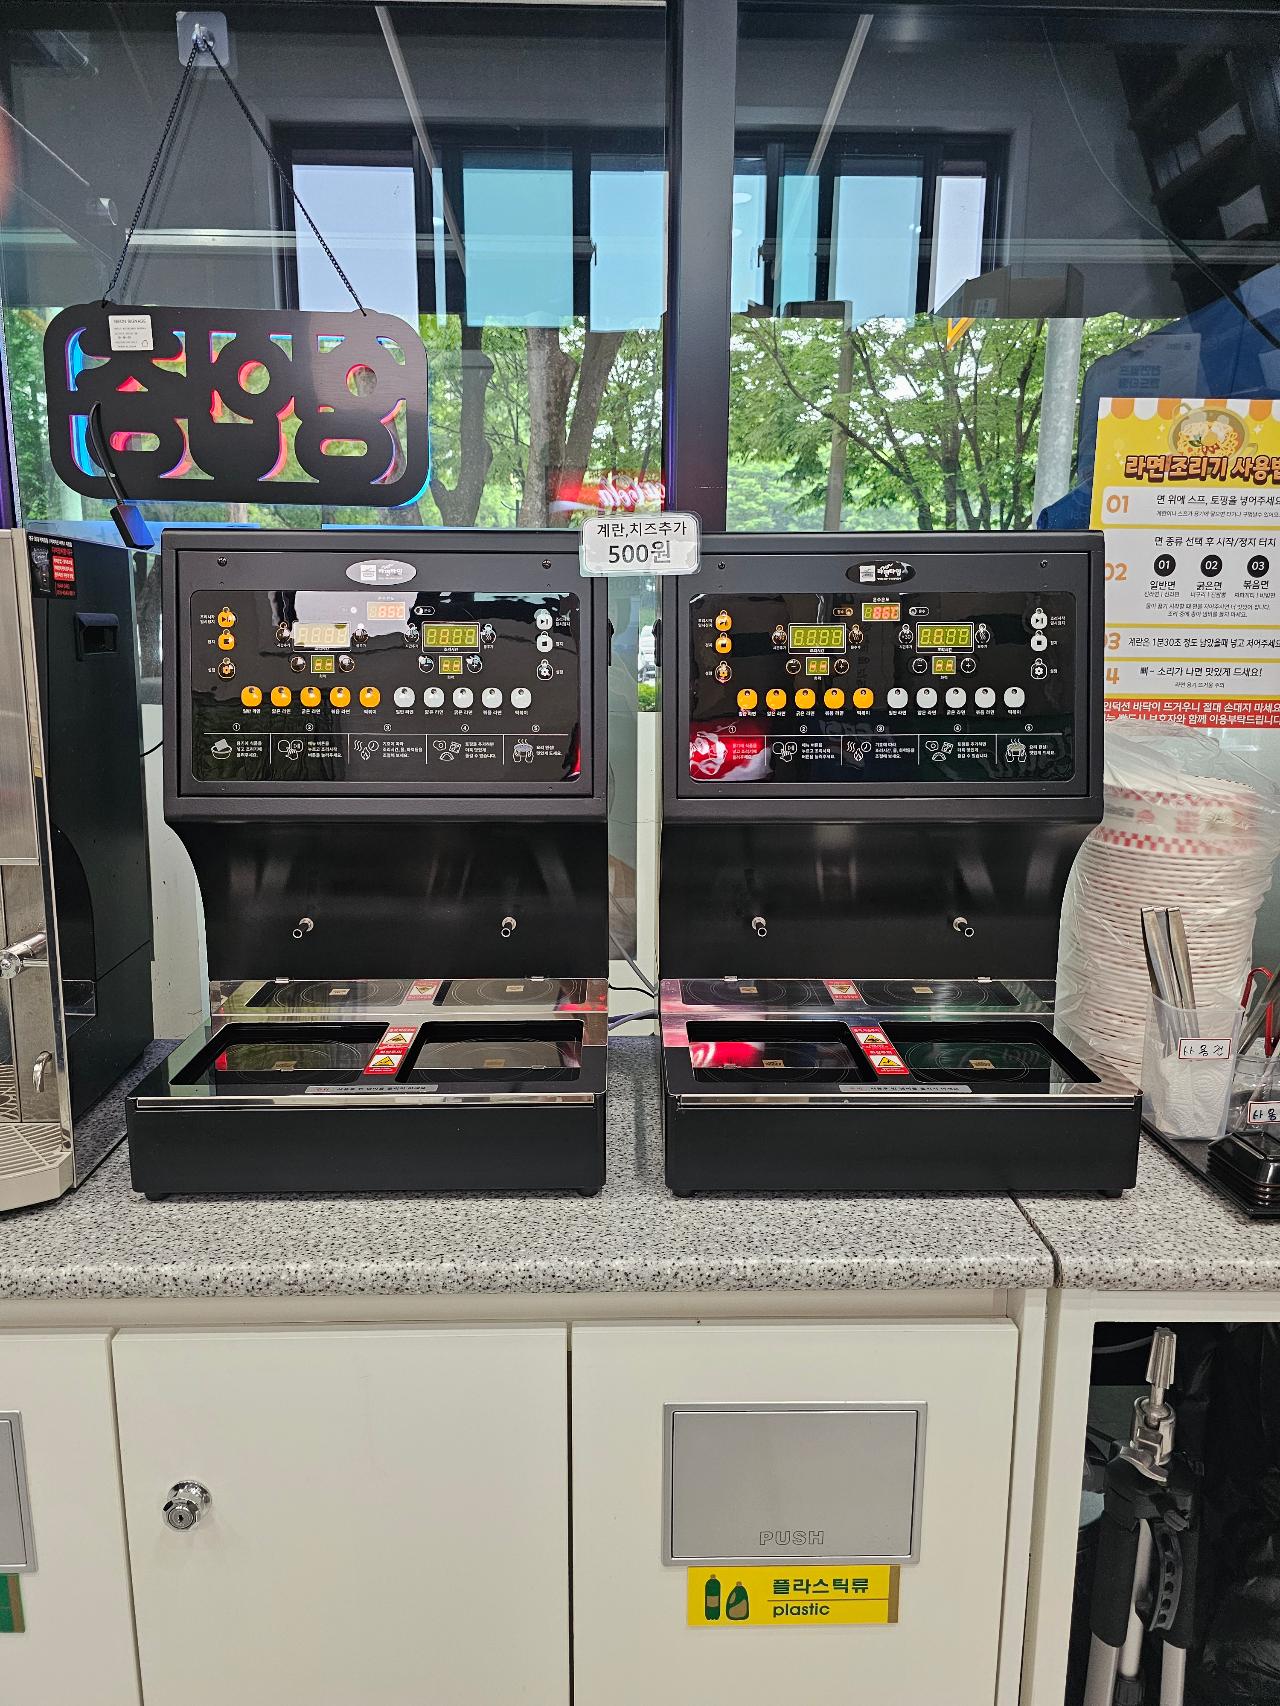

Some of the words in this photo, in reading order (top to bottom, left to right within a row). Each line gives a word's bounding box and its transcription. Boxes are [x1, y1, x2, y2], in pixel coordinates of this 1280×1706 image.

[1106, 494, 1129, 513] 01
[1157, 495, 1165, 505] 면
[1168, 495, 1185, 505] 위에
[1188, 495, 1208, 505] 스프,
[1210, 495, 1237, 505] 토핑을
[597, 522, 687, 538] 계란,치즈추가
[1155, 537, 1163, 547] 면
[1166, 537, 1183, 547] 종류
[1185, 537, 1203, 547] 선택
[1205, 537, 1214, 547] 후
[1217, 537, 1256, 547] 시작/정지
[1259, 537, 1277, 547] 터치
[608, 540, 671, 563] 500원
[1158, 560, 1170, 571] 01
[1206, 560, 1218, 571] 02
[1252, 560, 1265, 571] 03
[1150, 580, 1176, 590] 일반면
[1197, 580, 1222, 590] 굵은면
[1244, 580, 1269, 590] 볶음면
[1104, 632, 1121, 650] 3
[1128, 638, 1150, 648] 계란은
[1153, 638, 1181, 648] 1분30초
[1184, 638, 1198, 648] 정도
[1230, 638, 1244, 648] 넣고
[1158, 667, 1183, 677] 소리가
[1186, 667, 1203, 677] 나면
[1206, 667, 1231, 677] 맛있게
[1233, 667, 1263, 677] 드세요!
[1133, 702, 1161, 713] 바닥이
[1163, 702, 1200, 713] 뜨거우니
[1203, 702, 1222, 713] 절대
[1224, 702, 1251, 713] 손대지
[1188, 715, 1207, 725] 함께
[760, 1530, 824, 1546] PUSH
[772, 1578, 869, 1595] 플라스틱류
[773, 1603, 830, 1618] plastic
